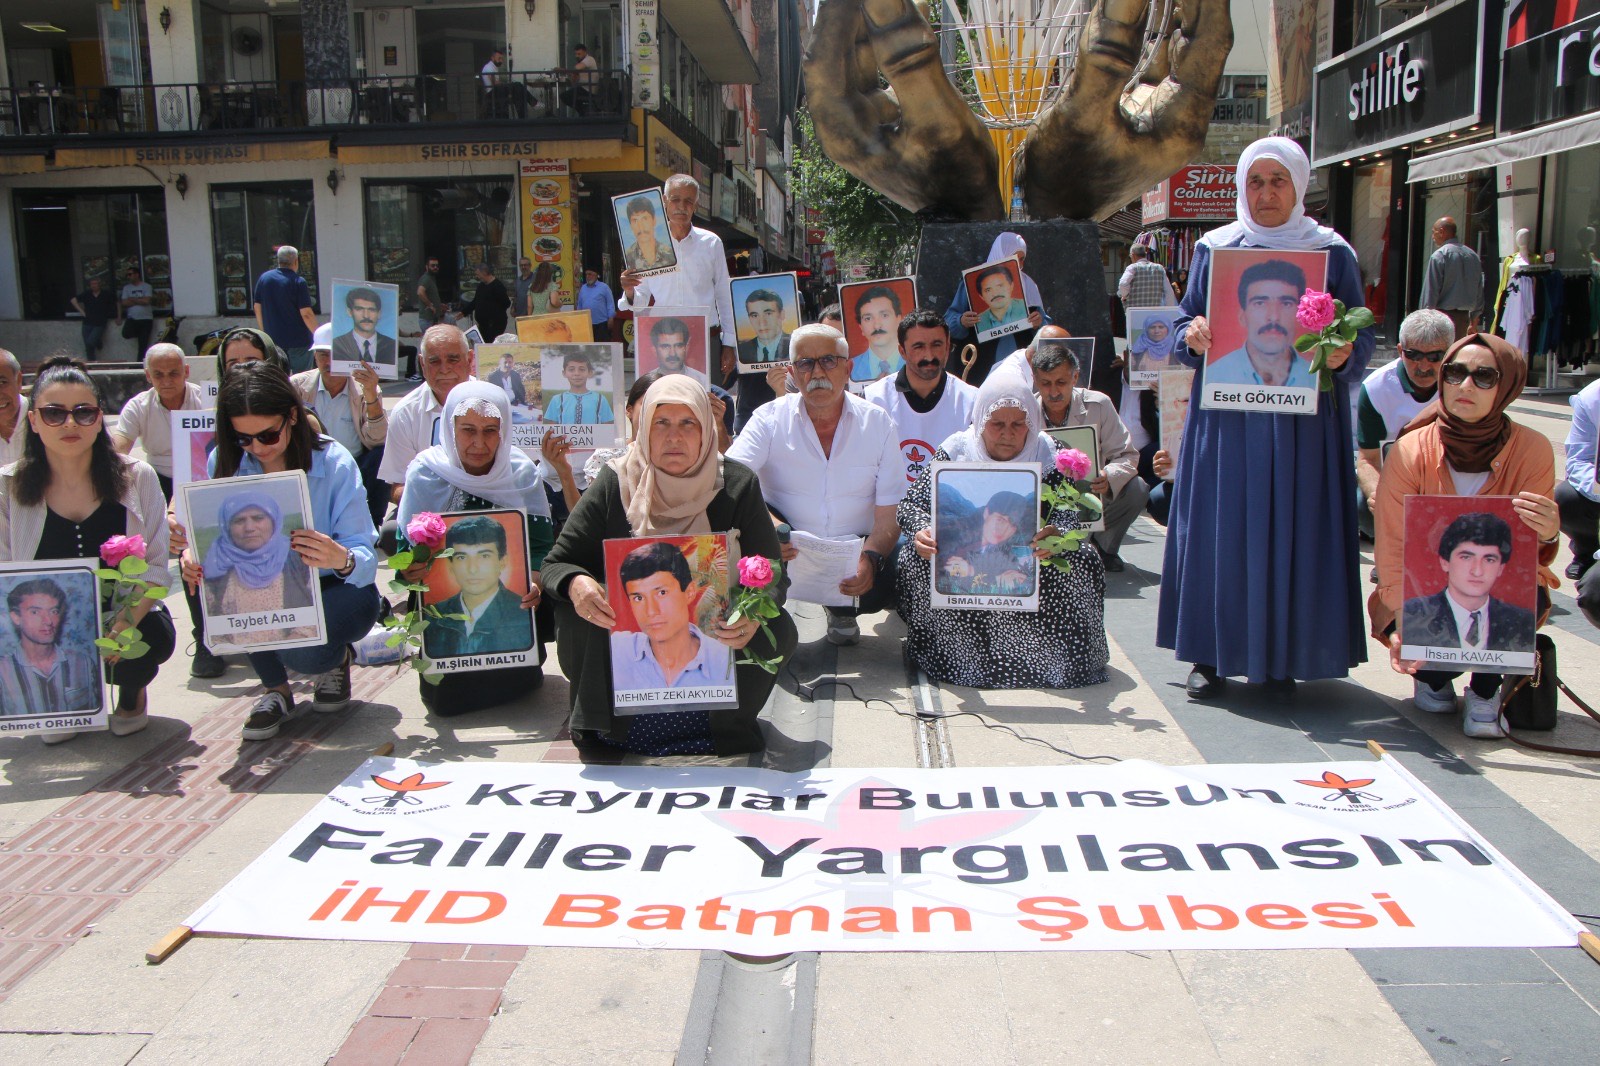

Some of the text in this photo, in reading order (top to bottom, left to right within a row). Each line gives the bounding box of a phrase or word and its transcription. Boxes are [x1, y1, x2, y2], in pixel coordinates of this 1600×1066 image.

[1349, 42, 1421, 120] stilife
[184, 144, 248, 160] SOFRASI
[471, 143, 537, 156] SOFRASI
[522, 165, 567, 173] SOFRASI
[1185, 168, 1237, 189] Şirin
[1174, 187, 1238, 199] Collectio
[1213, 389, 1306, 406] Eset GÖKTAYI
[182, 416, 215, 429] EDİP
[512, 424, 545, 435] RAHİM
[511, 436, 543, 446] EYSEL
[947, 595, 1023, 607] İSMAİL AĞAYA
[227, 613, 296, 630] Taybet Ana
[436, 654, 526, 670] M.ŞİRİN MALTU
[1425, 646, 1504, 664] İhsan KAVAK
[616, 689, 733, 703] MEHMET ZEKİ AKYILDIZ
[0, 717, 92, 731] ehmet ORHAN
[466, 783, 1287, 815] Kayıplar Bulunsun
[288, 822, 1492, 885] Failler Yargılansın
[308, 880, 1416, 942] İHD Batman Şubesi
